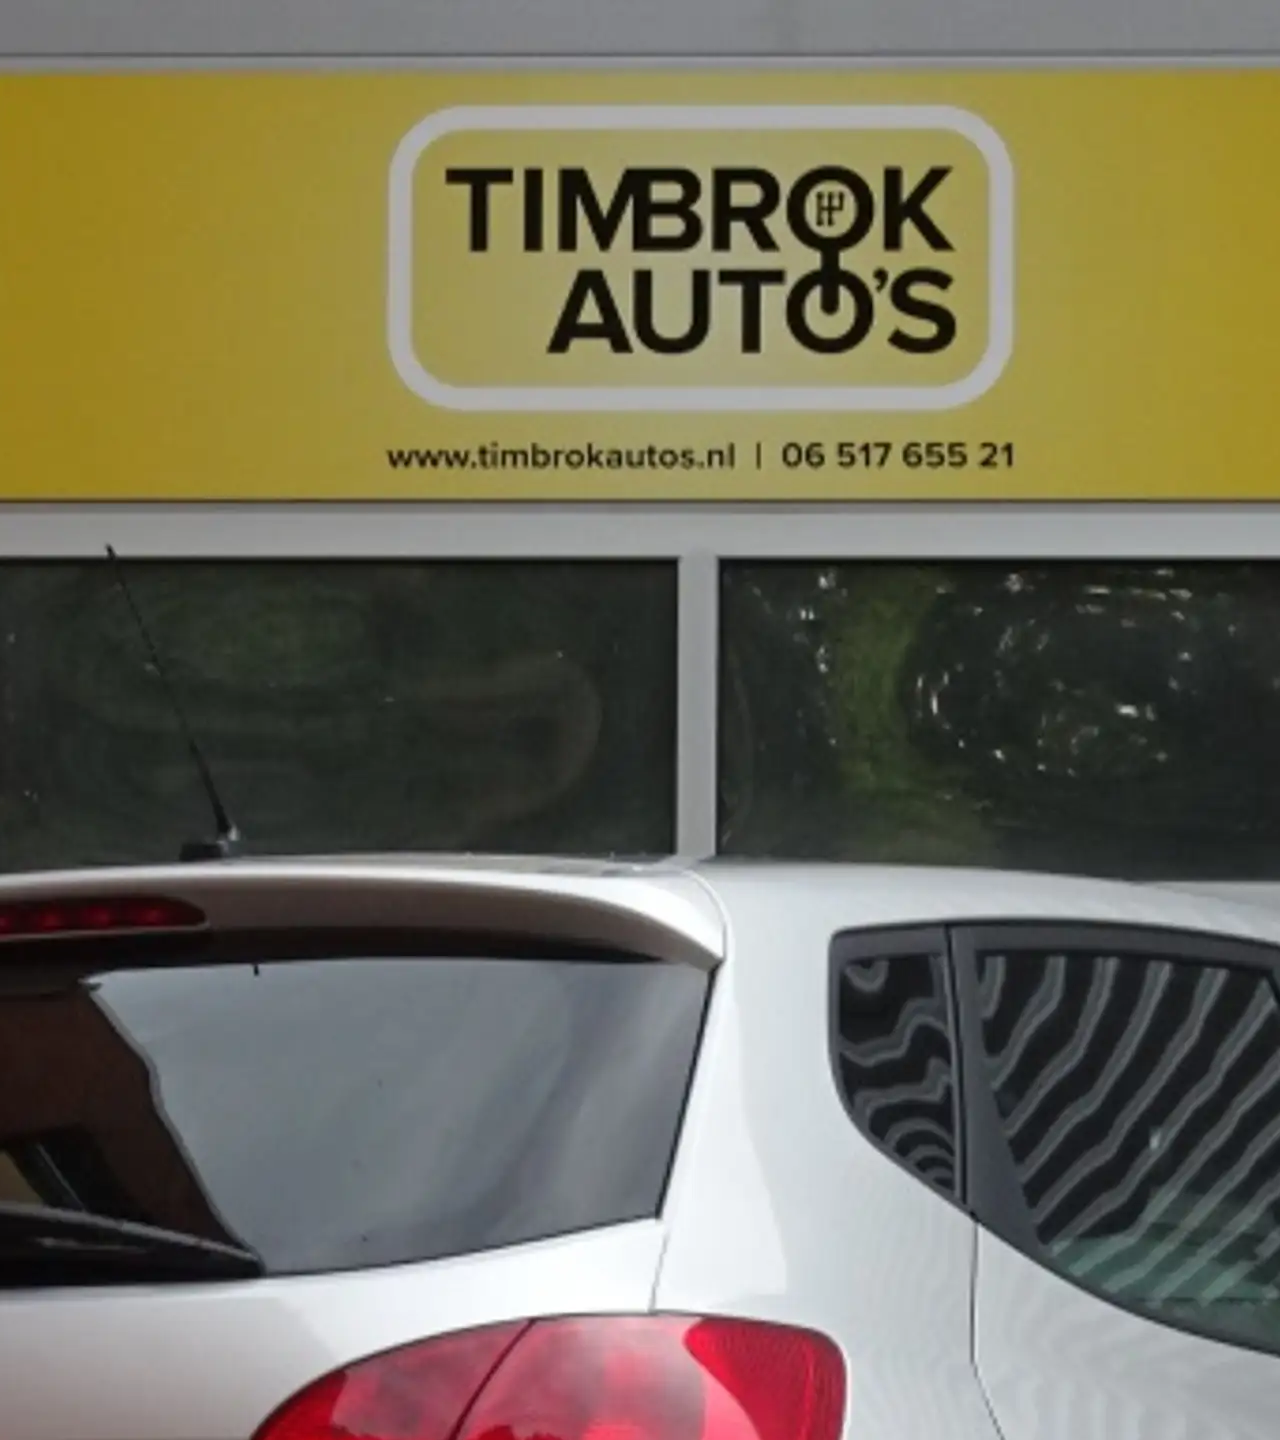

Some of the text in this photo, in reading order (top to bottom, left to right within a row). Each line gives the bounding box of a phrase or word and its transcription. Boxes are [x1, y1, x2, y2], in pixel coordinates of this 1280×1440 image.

[445, 165, 955, 251] TIMBROK
[547, 268, 957, 353] AUTO'S
[386, 441, 1014, 470] www.timbrokautos.nl 06 517 655 21
